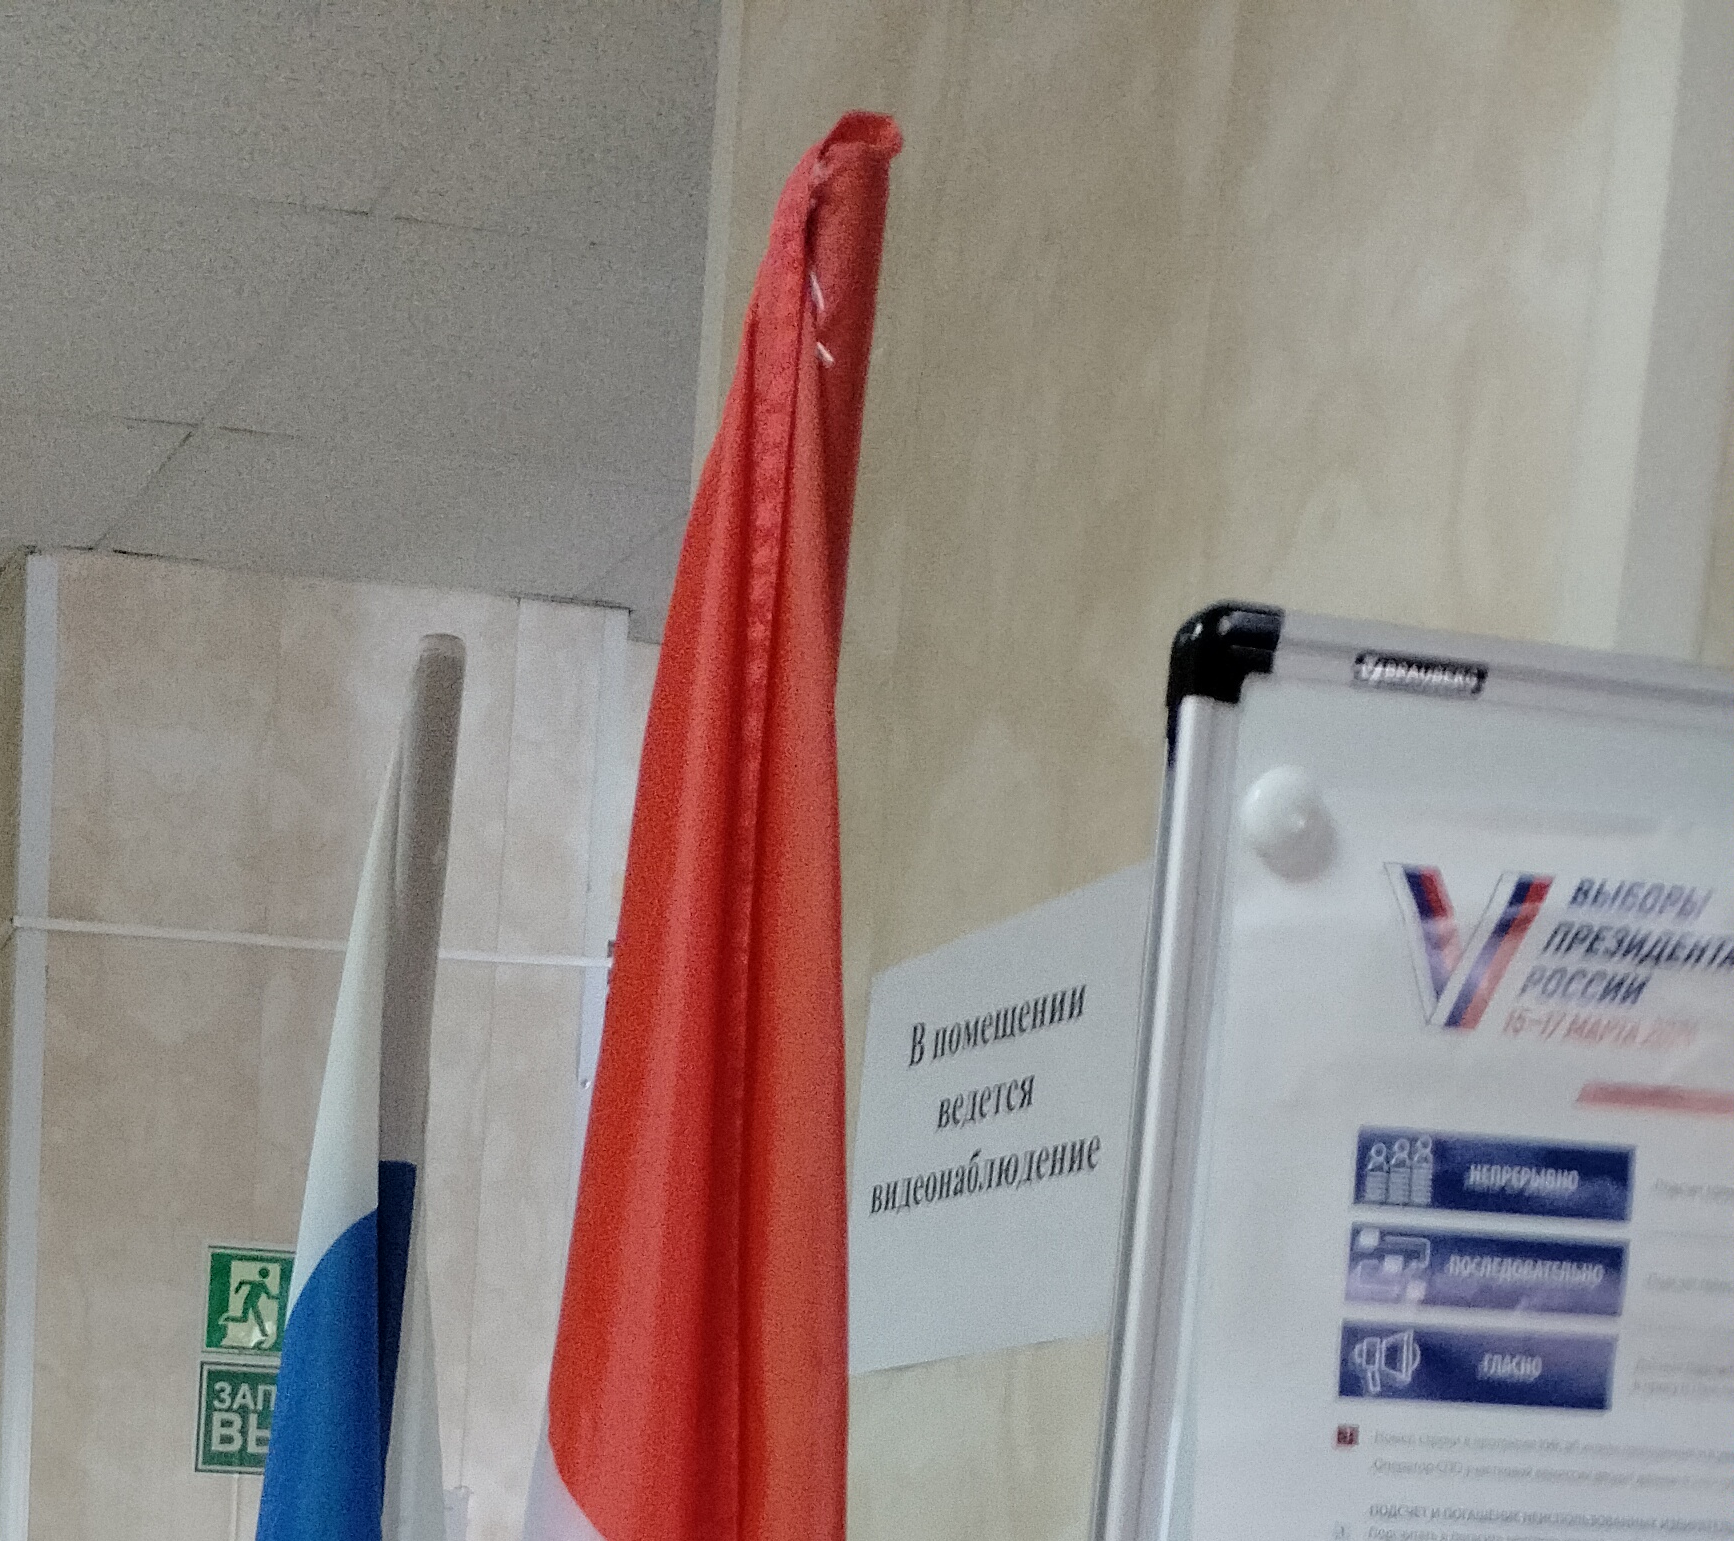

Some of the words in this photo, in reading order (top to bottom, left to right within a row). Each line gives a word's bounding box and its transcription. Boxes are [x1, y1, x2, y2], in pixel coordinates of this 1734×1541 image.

[1569, 877, 1712, 921] ВЫБОРЫ
[1542, 920, 1734, 970] ПРЕЗИДЕНТА
[1519, 964, 1651, 1006] РОССИИ
[908, 1021, 927, 1069] В
[932, 983, 1088, 1063] помещении
[936, 1074, 1036, 1130] ведется
[869, 1134, 1102, 1216] видеонаблюдение
